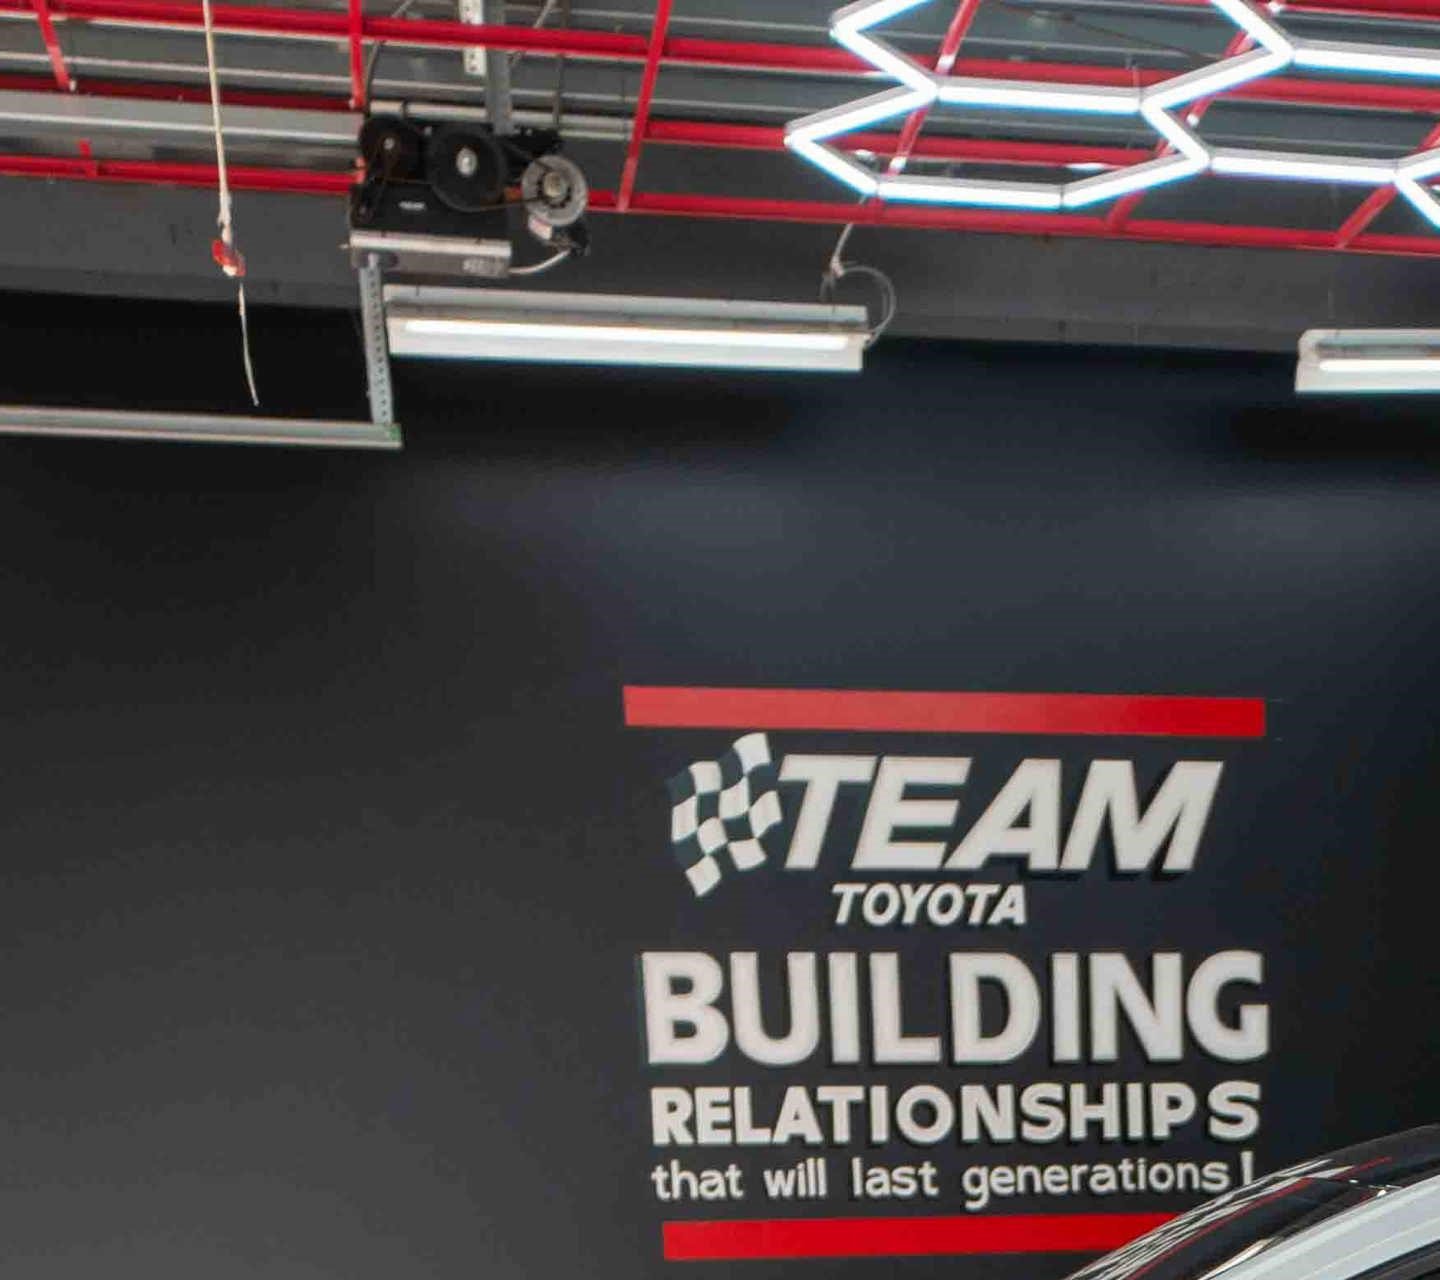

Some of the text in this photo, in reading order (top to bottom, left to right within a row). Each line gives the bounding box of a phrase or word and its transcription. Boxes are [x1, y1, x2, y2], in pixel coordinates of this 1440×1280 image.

[775, 754, 1224, 872] TEAM
[831, 883, 1027, 926] TOYOTA
[641, 950, 1270, 1065] BUILDING
[651, 1080, 1261, 1146] RELATIONSHIPS
[650, 1159, 744, 1200] that
[763, 1157, 827, 1198] will
[852, 1157, 940, 1198] last
